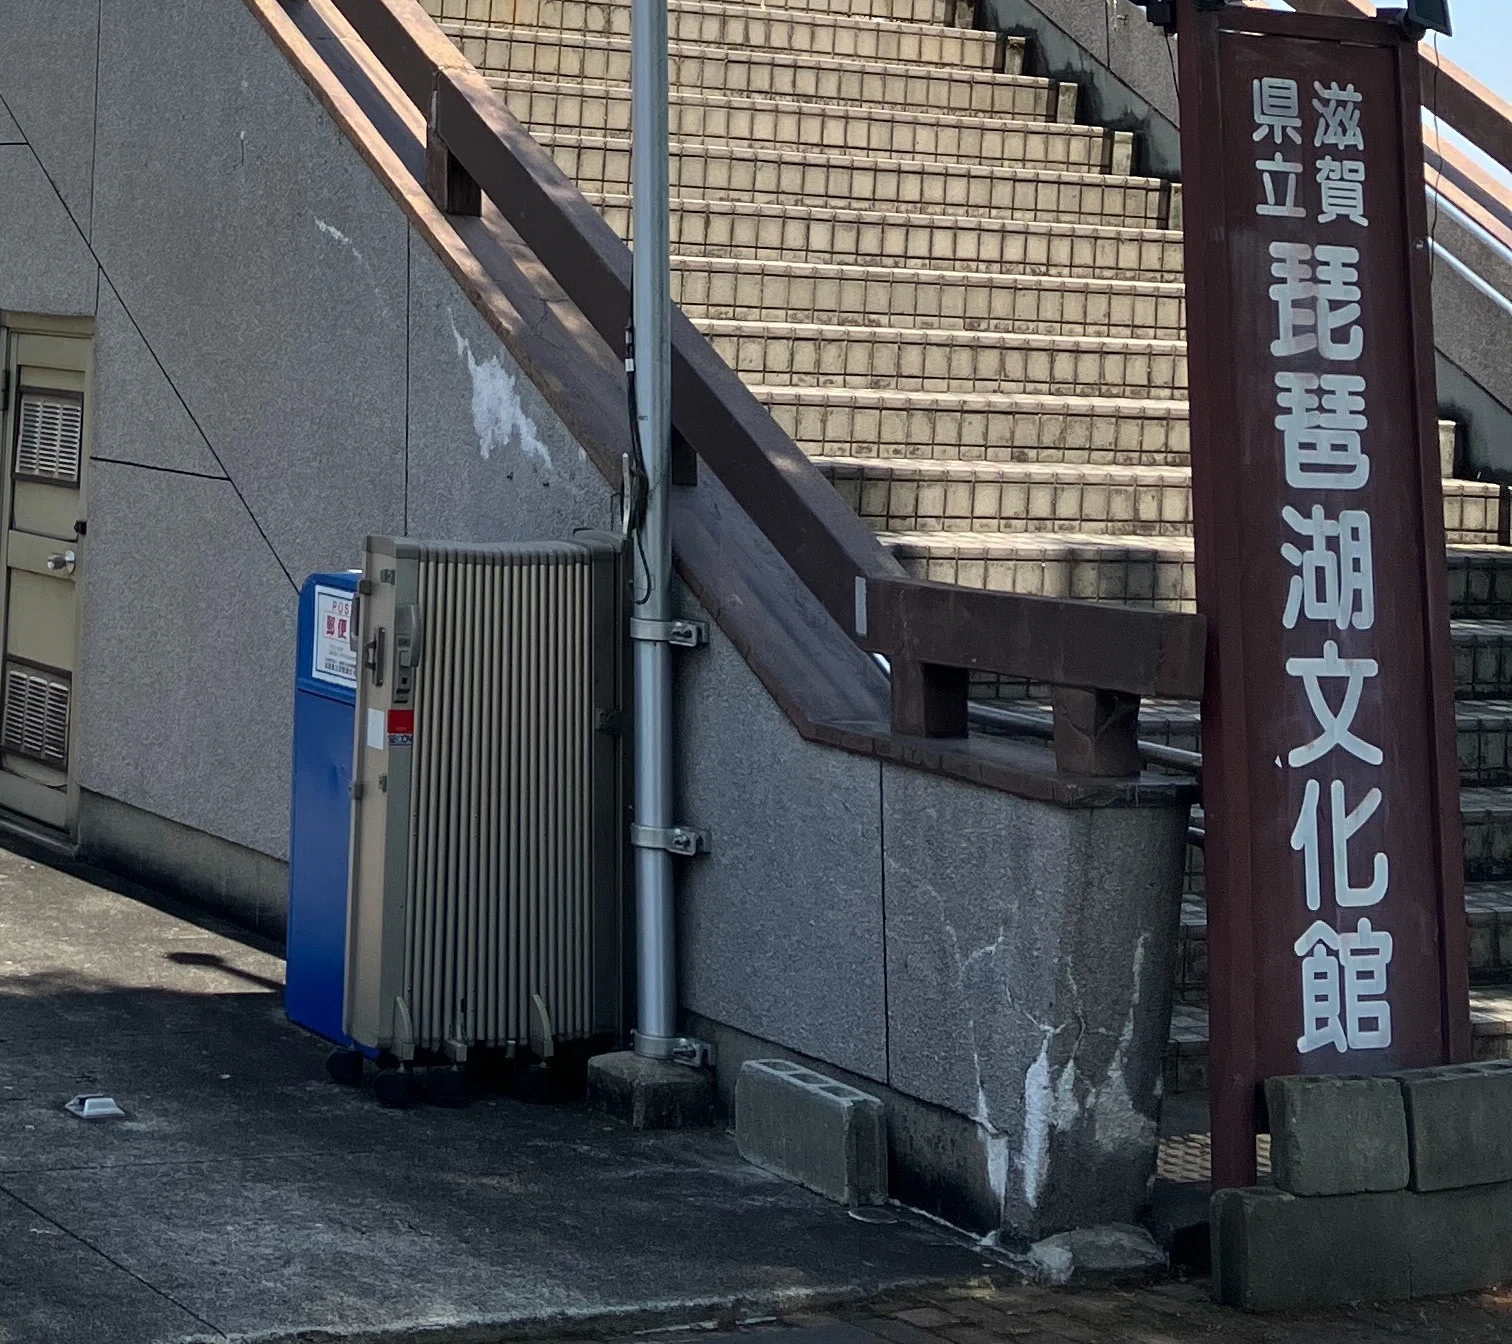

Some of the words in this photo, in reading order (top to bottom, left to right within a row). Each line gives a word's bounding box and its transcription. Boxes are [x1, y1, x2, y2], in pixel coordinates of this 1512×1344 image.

[1253, 77, 1306, 217] 県立
[1312, 80, 1369, 226] 滋賀
[326, 615, 348, 640] 郵便
[332, 600, 350, 616] POS
[1268, 241, 1393, 1054] 琵琶湖文化館
